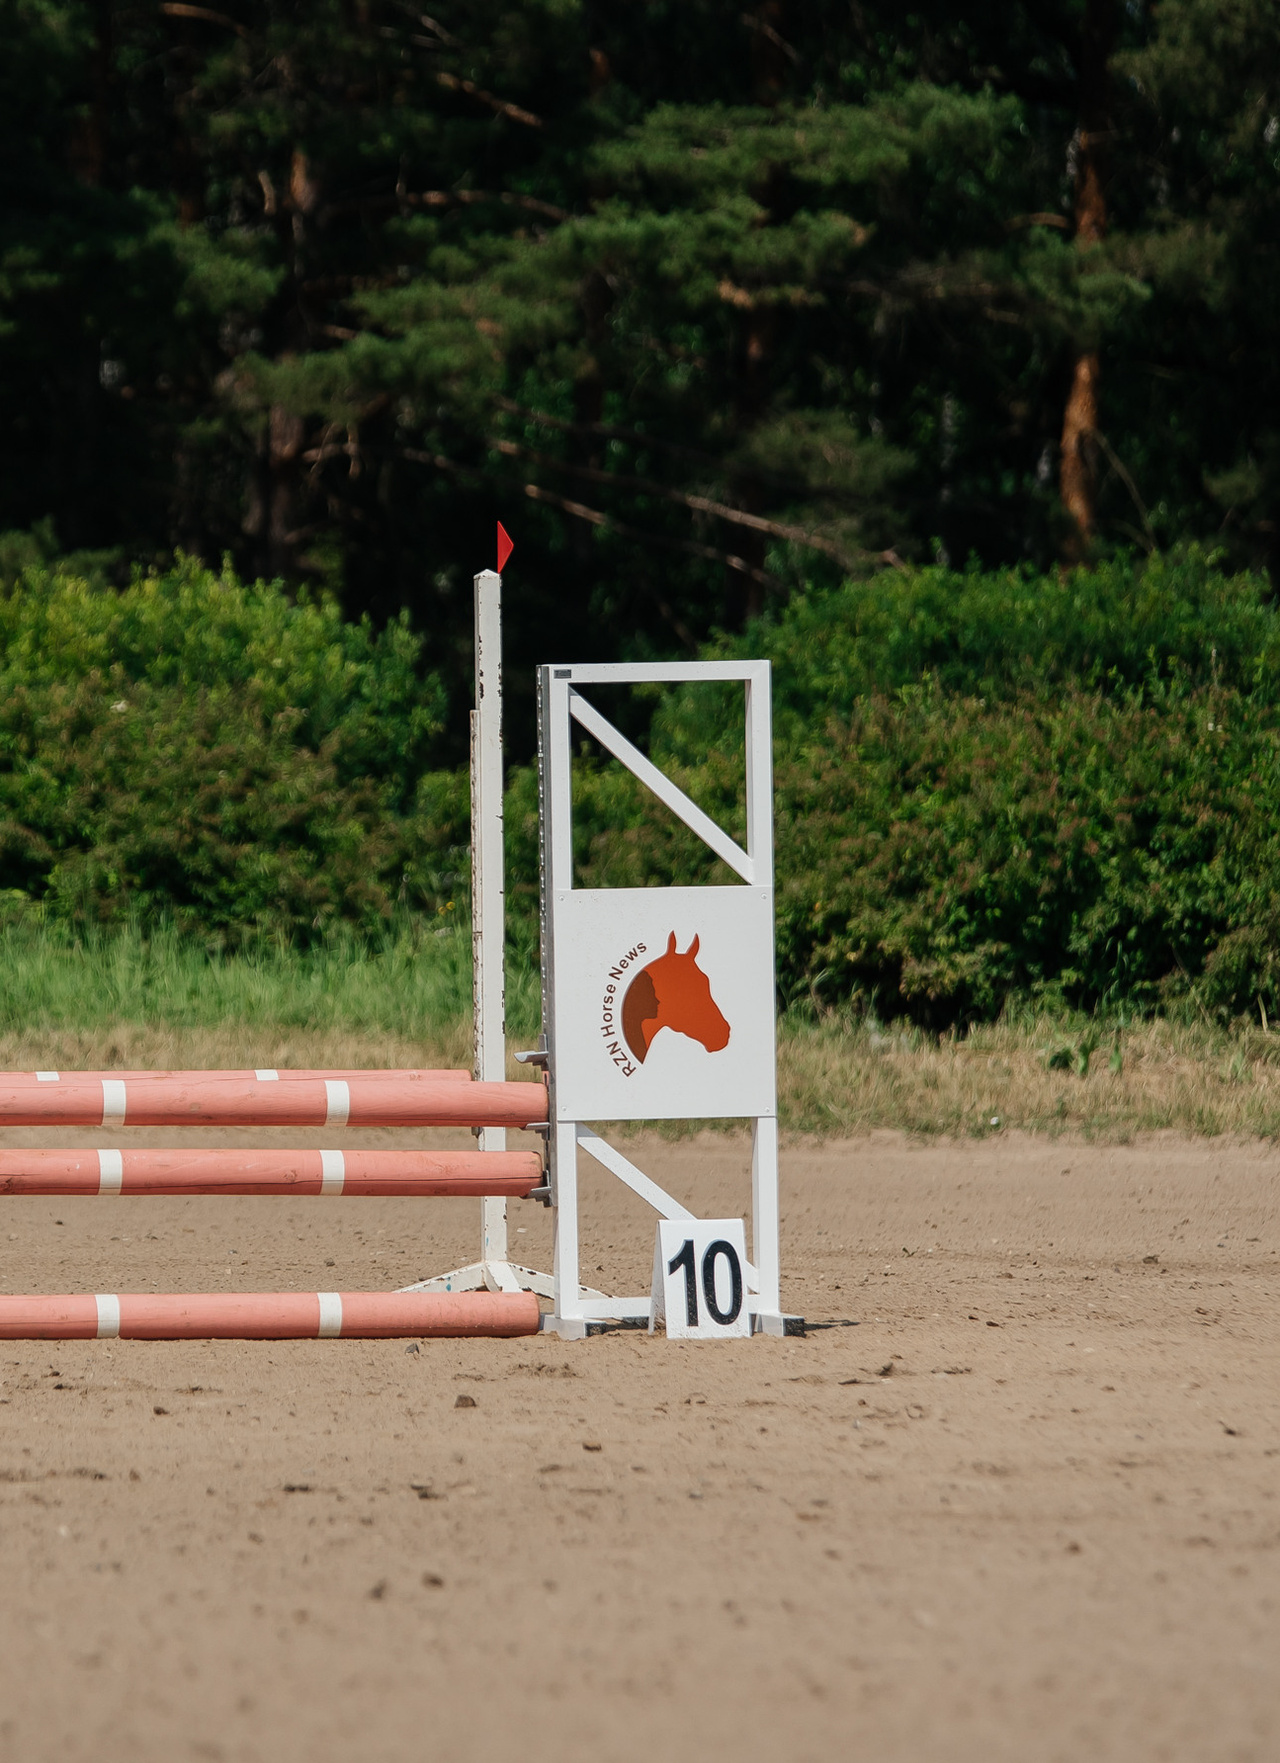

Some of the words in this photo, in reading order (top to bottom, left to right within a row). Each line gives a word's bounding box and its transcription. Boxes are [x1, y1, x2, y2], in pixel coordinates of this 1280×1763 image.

[608, 942, 647, 981] News
[600, 983, 617, 1038] Horse
[606, 1041, 637, 1078] RZN
[667, 1239, 743, 1327] 10
